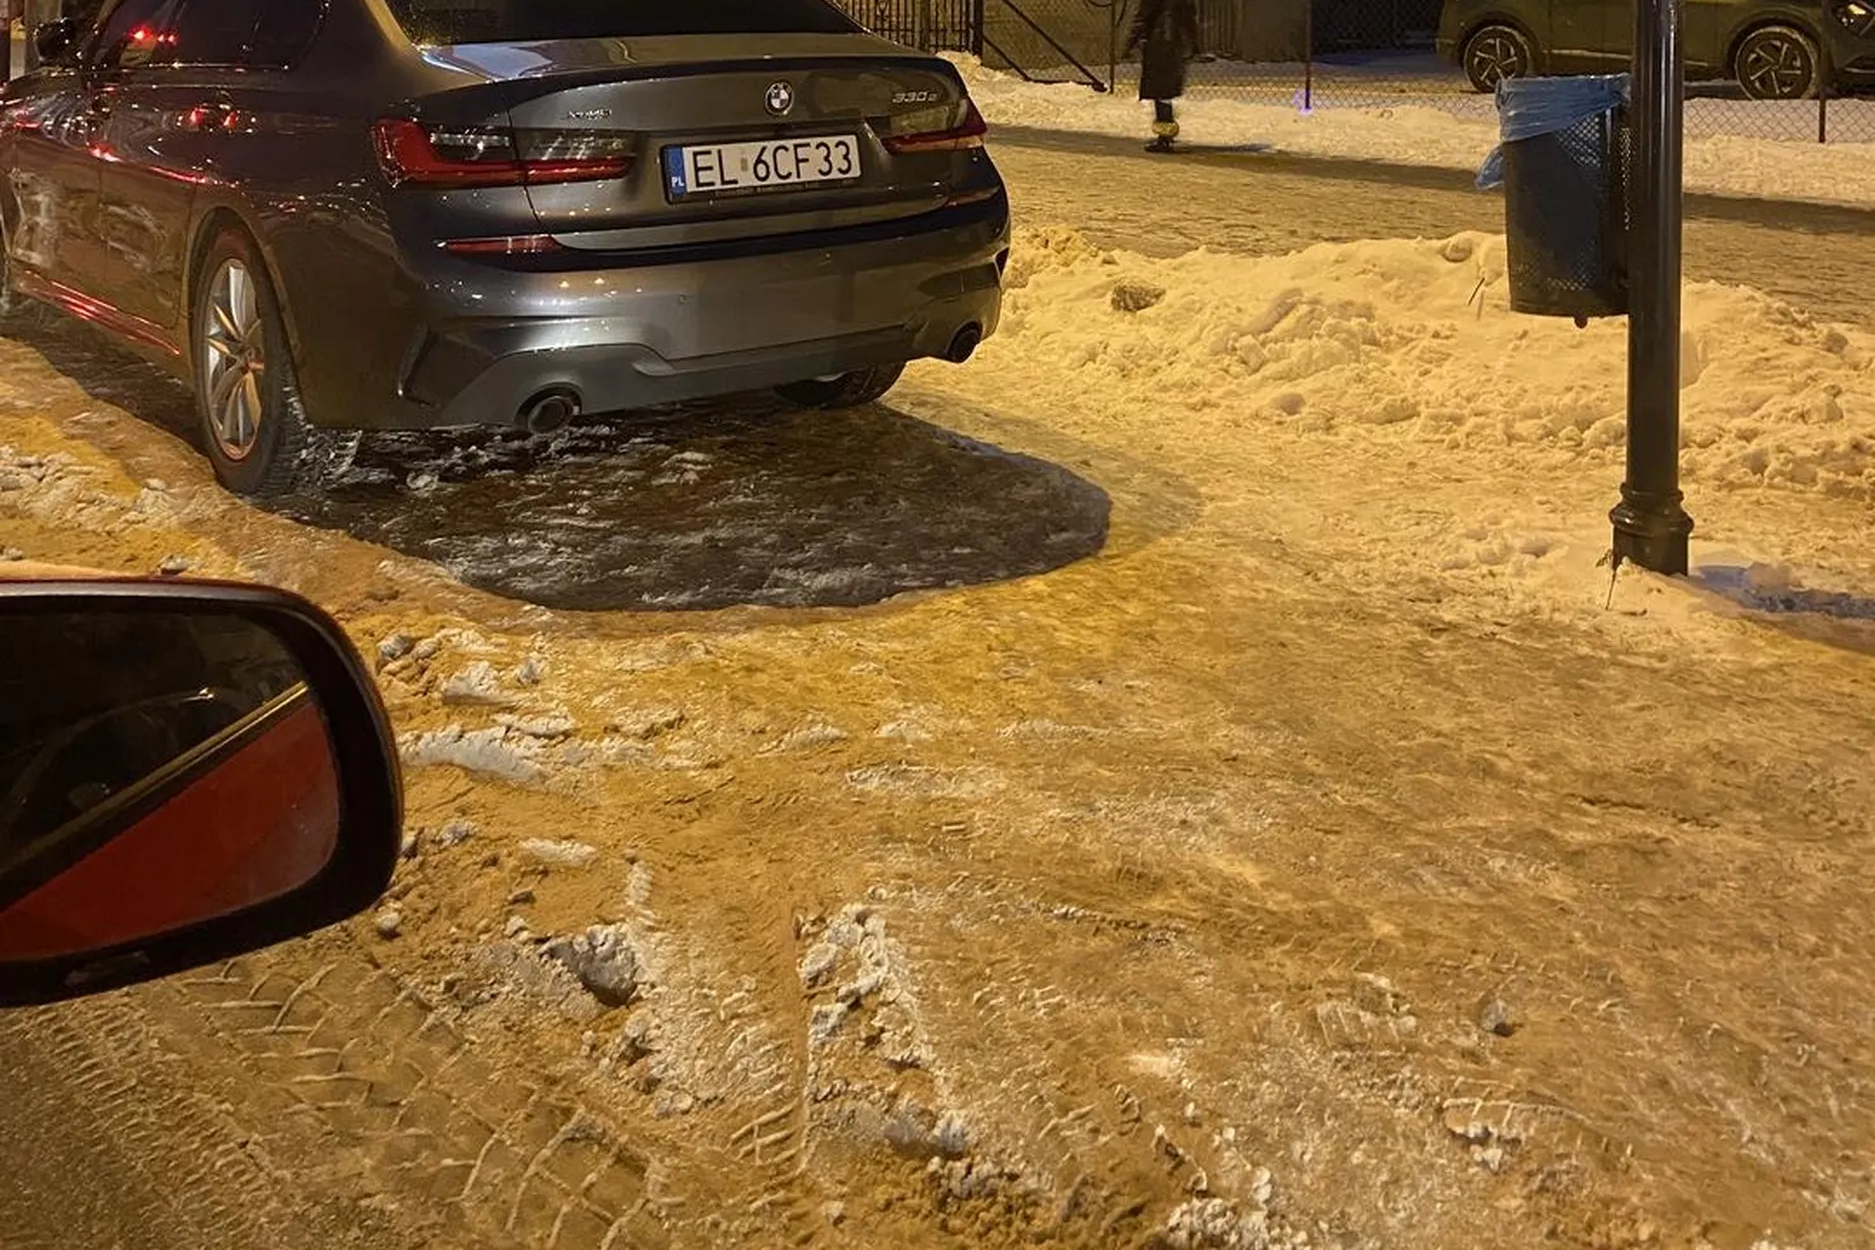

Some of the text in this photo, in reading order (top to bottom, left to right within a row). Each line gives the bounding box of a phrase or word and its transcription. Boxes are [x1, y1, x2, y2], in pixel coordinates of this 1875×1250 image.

[692, 148, 738, 188] EL
[753, 140, 851, 183] 6CF33
[671, 176, 685, 188] PL
